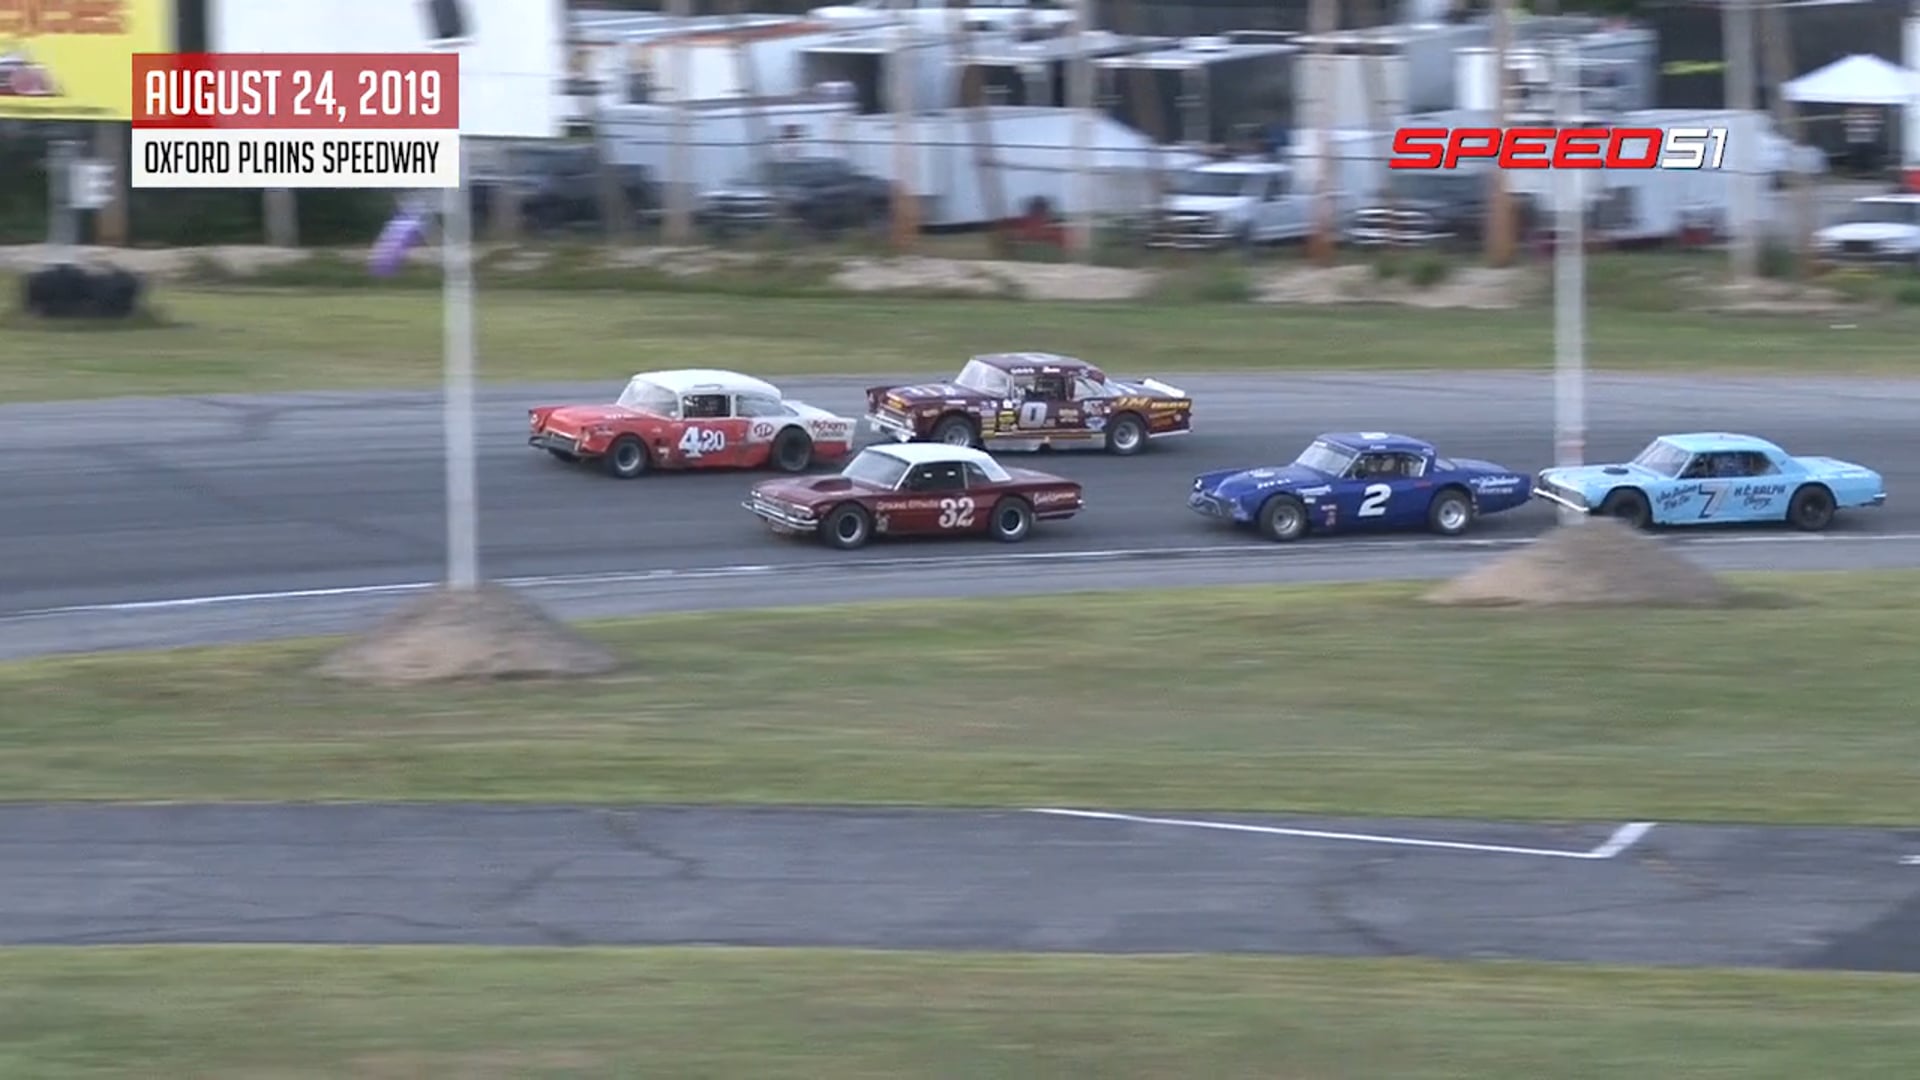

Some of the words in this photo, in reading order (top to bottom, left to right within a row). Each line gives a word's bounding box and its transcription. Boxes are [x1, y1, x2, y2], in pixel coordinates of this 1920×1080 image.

[1019, 401, 1048, 429] 0
[939, 497, 986, 528] 32
[1358, 483, 1392, 517] 2
[1698, 482, 1731, 519] 7
